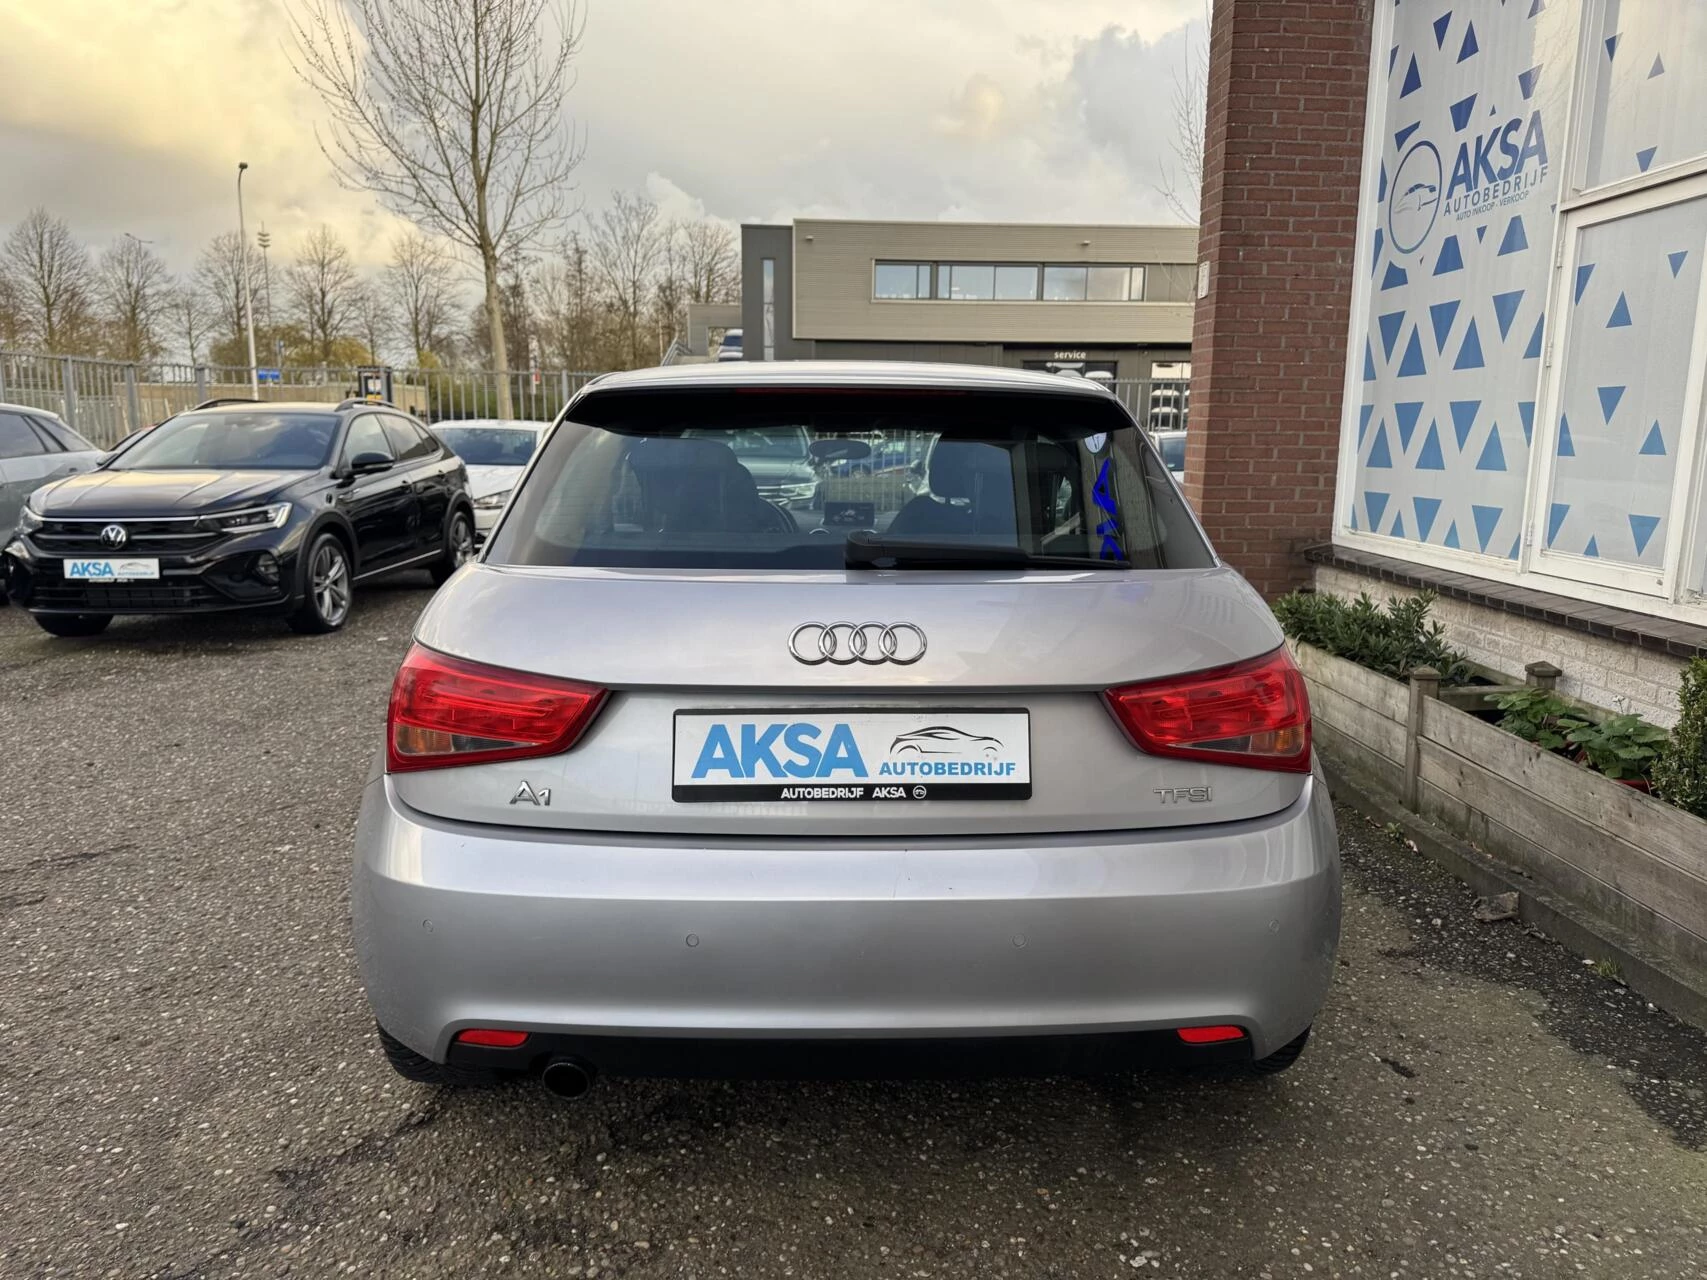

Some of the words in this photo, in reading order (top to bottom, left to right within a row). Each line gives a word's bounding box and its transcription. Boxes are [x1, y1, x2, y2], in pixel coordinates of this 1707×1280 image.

[1446, 110, 1548, 200] AKSA
[1444, 166, 1548, 216] AUTOBEDRIJF
[1456, 210, 1471, 221] AUTO
[1472, 202, 1495, 215] INKOOP
[1500, 190, 1529, 206] VERKOOP
[1054, 350, 1086, 360] service
[69, 562, 115, 576] AKSA
[691, 723, 869, 779] AKSA
[879, 762, 1016, 776] AUTOBEDRIJF
[509, 780, 551, 806] A1
[781, 787, 864, 799] AUTOBEDRIJF
[872, 787, 906, 799] AKSA
[1153, 786, 1213, 804] TFSI
